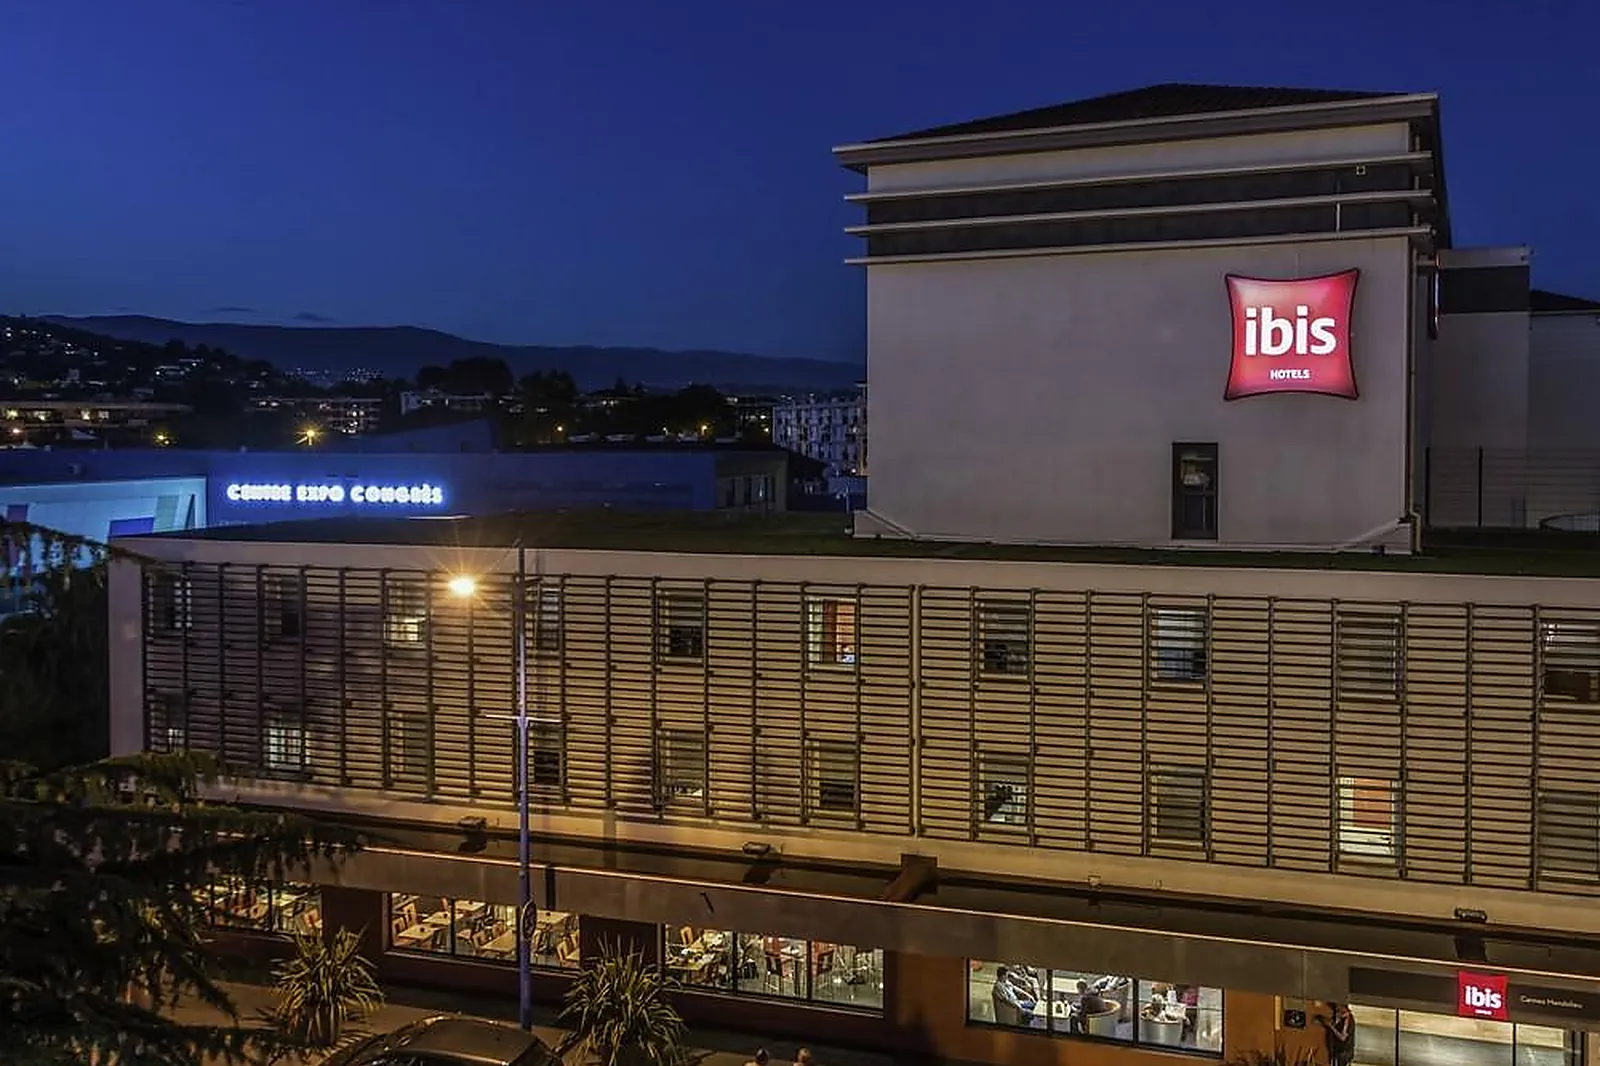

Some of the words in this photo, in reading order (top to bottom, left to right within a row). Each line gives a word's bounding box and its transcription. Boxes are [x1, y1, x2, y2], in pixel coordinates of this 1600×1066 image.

[1245, 305, 1337, 355] ibis
[1270, 369, 1311, 379] HOTELS
[296, 485, 345, 502] EXPO
[1464, 985, 1502, 1009] ibis
